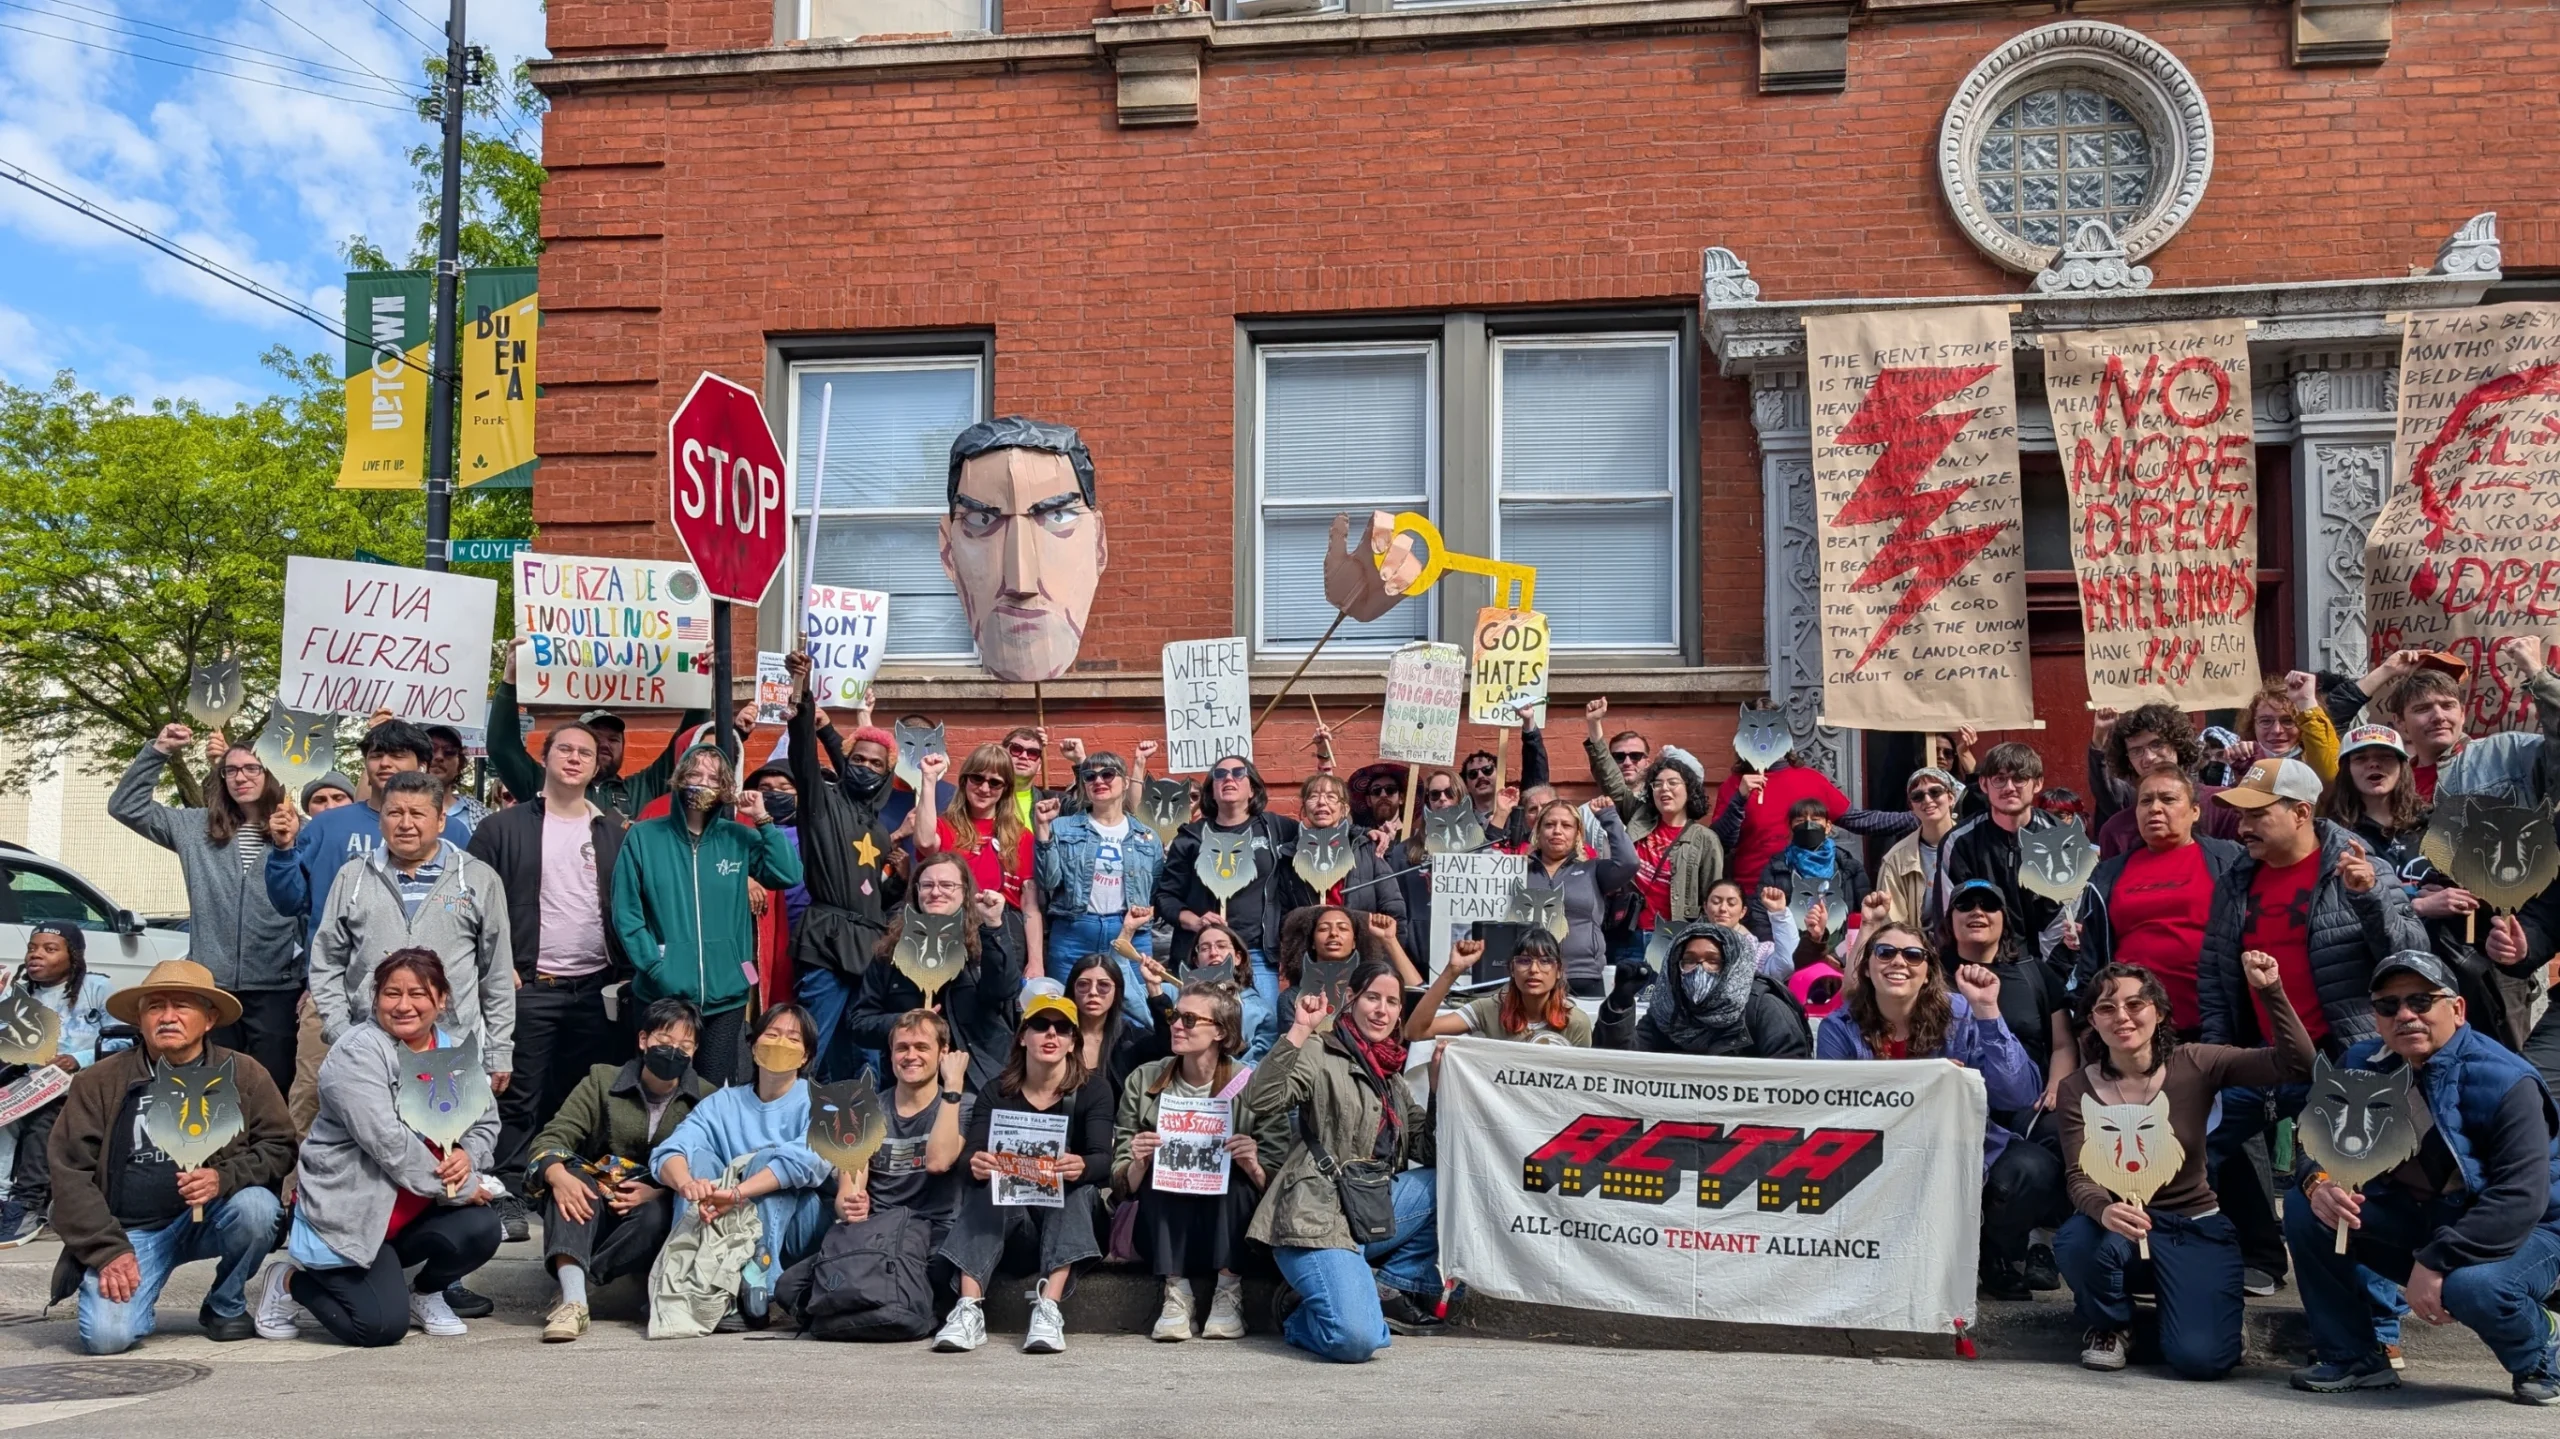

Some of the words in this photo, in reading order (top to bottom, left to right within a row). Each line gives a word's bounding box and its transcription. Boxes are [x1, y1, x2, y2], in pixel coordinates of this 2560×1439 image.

[2409, 318, 2439, 338] IT
[2442, 315, 2489, 335] HAS
[2501, 311, 2560, 330] BEEN
[1819, 354, 1860, 369] THE
[1874, 346, 1930, 366] RENT
[1936, 340, 2009, 359] STRIKE
[2048, 349, 2077, 362] TO
[2088, 340, 2164, 358] TENANTS
[2168, 336, 2206, 350] LIKE
[2213, 335, 2234, 346] US
[2405, 339, 2494, 362] MONTHS
[372, 296, 405, 430] UPTOWN
[2404, 363, 2501, 385] BELDEN
[1819, 378, 1835, 392] IS
[1843, 374, 1878, 390] THE
[2048, 374, 2082, 388] THE
[2093, 354, 2231, 429] NO
[1817, 395, 1903, 416] HEAVIEST
[1913, 385, 1989, 405] SWORD
[2053, 395, 2113, 414] MEANS
[2176, 384, 2215, 403] THE
[474, 416, 505, 425] Park
[1817, 421, 1880, 437] BECAUSE
[1916, 406, 2008, 426] REALIZES
[2060, 420, 2118, 437] STRIKE
[1817, 442, 1890, 458] DIRECTLY
[1953, 426, 2015, 443] OTHER
[363, 460, 380, 471] LIVE
[382, 460, 391, 470] IT
[1817, 468, 1882, 481] WEAPONS
[1936, 452, 1989, 467] ONLY
[2072, 432, 2250, 495] MORE
[681, 438, 780, 539] STOP
[1820, 485, 1908, 501] THREATEN
[1915, 482, 1932, 492] TO
[1940, 471, 2015, 490] REALIZE.
[1946, 494, 2020, 515] DOESN'T
[1827, 535, 1870, 549] BEAT
[1877, 528, 1935, 547] AROUND
[1943, 524, 1973, 537] THE
[2085, 499, 2253, 562] DREW
[2373, 518, 2431, 539] FORM
[2454, 517, 2471, 530] A
[459, 547, 466, 555] W
[1824, 561, 1836, 572] IT
[1841, 559, 1887, 572] BEATS
[1982, 545, 2023, 560] BANK.
[523, 561, 624, 602] FUERZA
[634, 568, 657, 601] DE
[2151, 561, 2187, 577] AND
[1823, 582, 1836, 593] IT
[1842, 582, 1883, 594] TAKES
[1892, 574, 1981, 592] ADVANTAGE
[1993, 571, 2016, 583] OF
[344, 579, 431, 622] VIVA
[808, 588, 882, 612] DREW
[1825, 603, 1854, 615] THE
[1867, 602, 1941, 615] UMBILICAL
[1951, 599, 1999, 611] CORD
[524, 605, 672, 639] INQUILINOS
[808, 613, 877, 637] DON'T
[1827, 626, 1872, 638] THAT
[1887, 623, 1925, 635] TIES
[1933, 621, 1966, 634] THE
[1976, 618, 2025, 633] UNION
[2371, 612, 2457, 636] NEARLY
[1480, 622, 1542, 651] GOD
[2090, 643, 2131, 661] HAVE
[2211, 635, 2245, 654] EACH
[300, 627, 451, 674] FUERZAS
[530, 634, 672, 677] BROADWAY
[807, 642, 869, 670] KICK
[1168, 642, 1244, 680] WHERE
[1832, 648, 1854, 659] TO
[1869, 648, 1900, 660] THE
[1912, 640, 2023, 659] LANDLORD'S
[1391, 661, 1463, 688] DISPLACES
[1477, 660, 1542, 686] HATES
[1828, 671, 1892, 684] CIRCUIT
[1903, 668, 1925, 681] OF
[1935, 665, 2018, 681] CAPITAL.
[2092, 667, 2152, 685] MONTH
[2170, 663, 2191, 680] ON
[2203, 661, 2246, 680] RENT!
[290, 673, 467, 722] INQUILINOS
[567, 672, 665, 703] CUYLER
[1188, 682, 1218, 704] IS
[1387, 681, 1460, 708] CHICAGO'S
[1171, 706, 1242, 731] DREW
[1387, 703, 1457, 727] WORKING
[1386, 725, 1452, 749] CLASS
[1170, 735, 1250, 768] MILLARD
[1407, 750, 1427, 758] FIGHT
[1433, 855, 1481, 874] HAVE
[1489, 856, 1525, 875] YOU
[1434, 875, 1478, 895] SEEN
[1450, 898, 1507, 918] MAN?
[1164, 1098, 1193, 1106] TENANTS
[1495, 1070, 1578, 1091] ALIANZA
[1583, 1075, 1608, 1093] DE
[1613, 1076, 1728, 1103] INQUILINOS
[1733, 1086, 1760, 1103] DE
[1764, 1087, 1820, 1105] TODO
[1824, 1089, 1915, 1108] CHICAGO
[1164, 1117, 1188, 1129] RENT
[1523, 1113, 1884, 1191] ACTA
[1510, 1214, 1659, 1247] ALL-CHICAGO
[1664, 1228, 1761, 1254] TENANT
[1765, 1238, 1881, 1260] ALLIANCE
